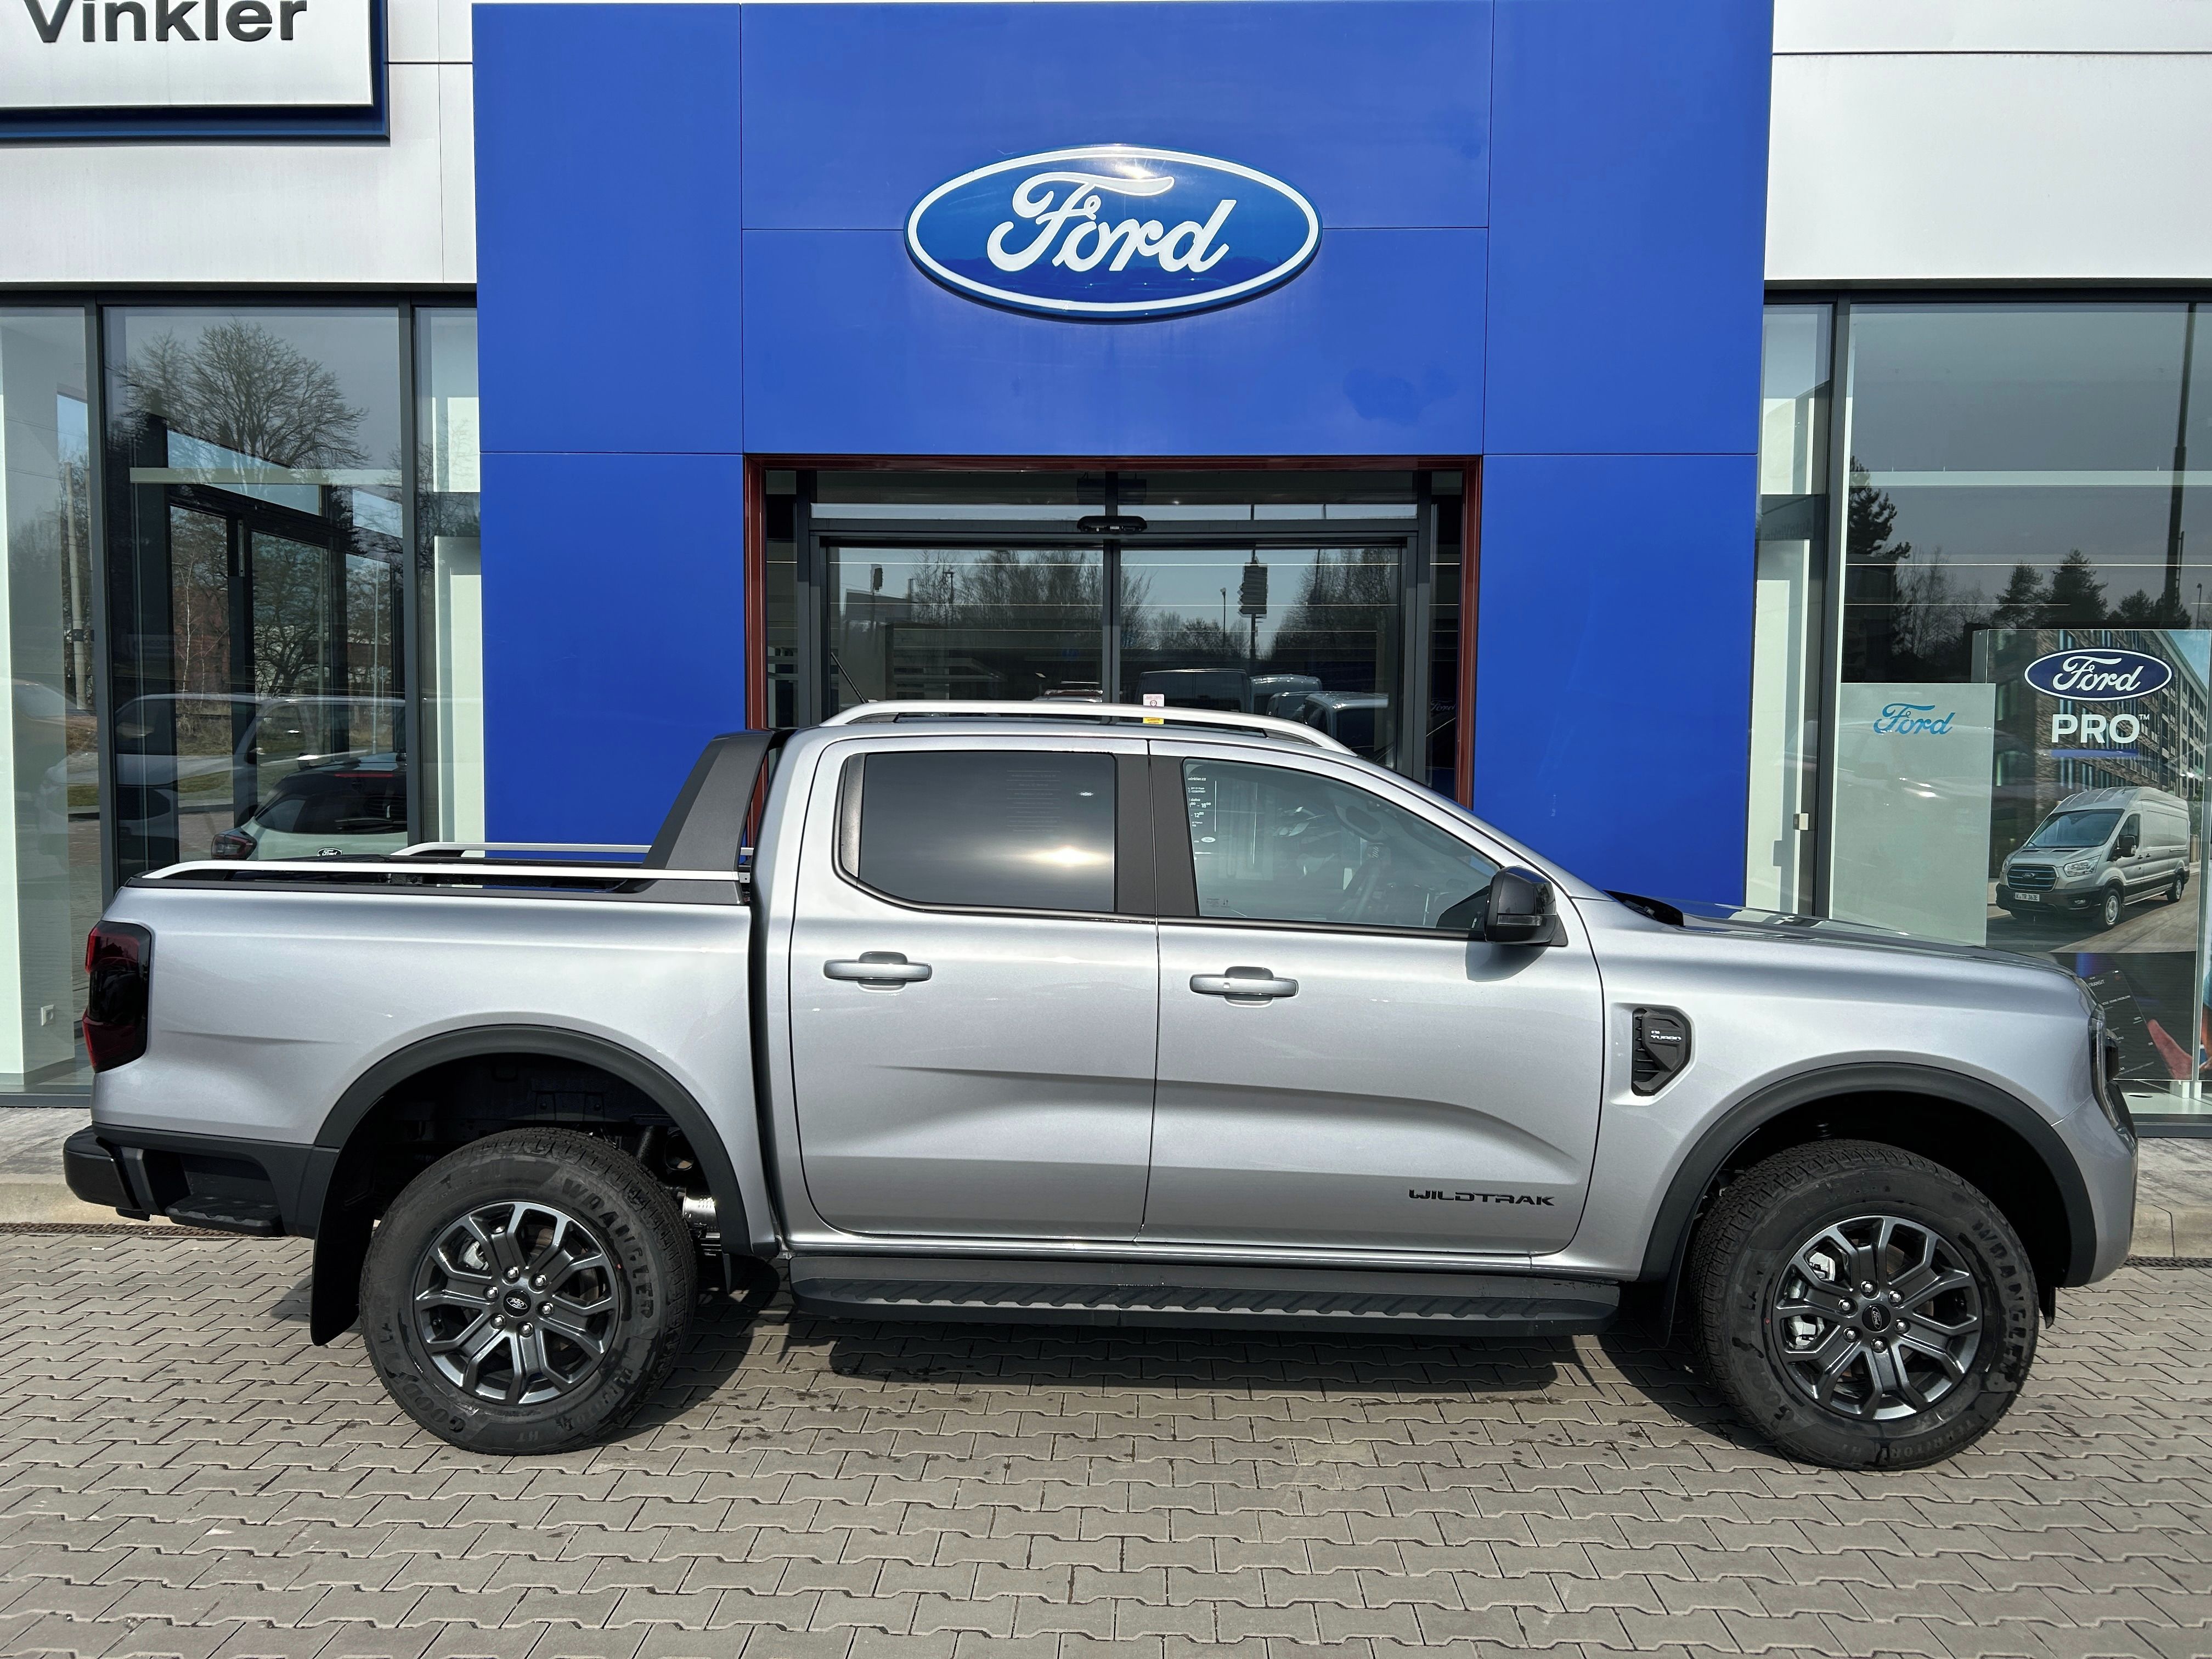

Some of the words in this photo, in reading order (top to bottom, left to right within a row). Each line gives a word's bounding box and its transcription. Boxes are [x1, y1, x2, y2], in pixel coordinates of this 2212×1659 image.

[25, 0, 307, 43] Vinkler
[987, 171, 1237, 272] Ford
[2052, 654, 2144, 693] Ford
[1873, 703, 1956, 735] Ford
[1408, 1189, 1555, 1206] WILDTRAK
